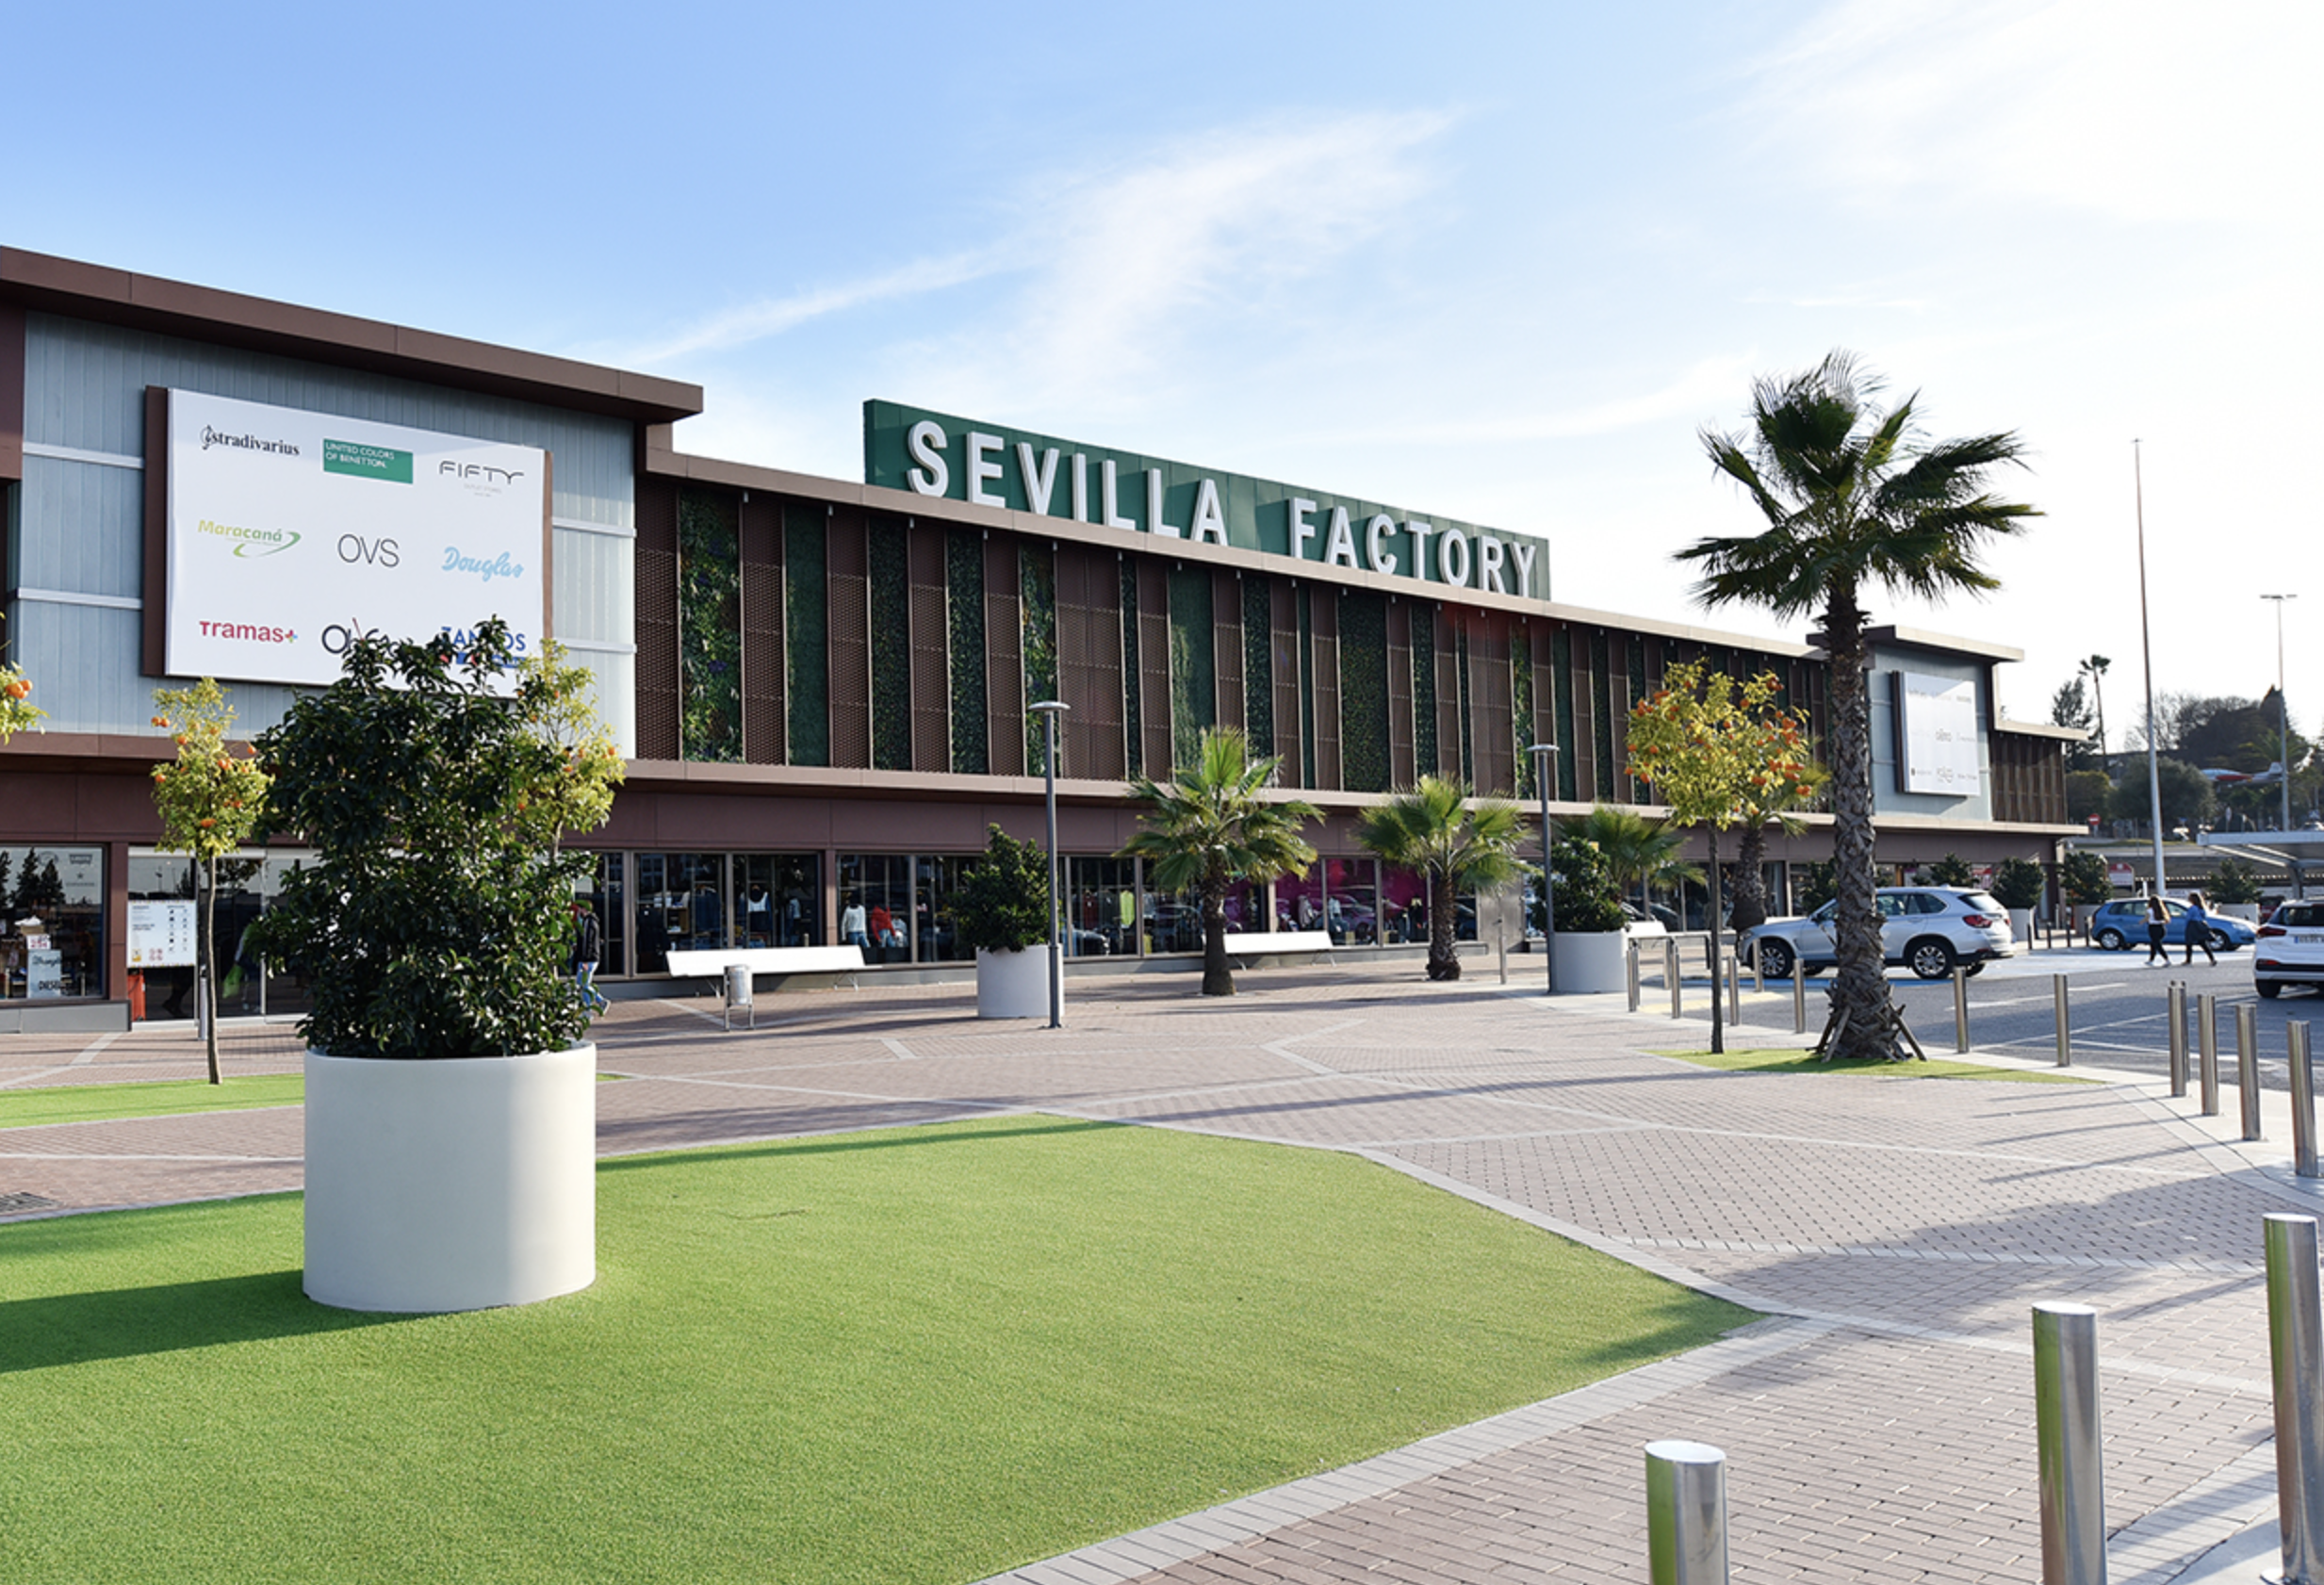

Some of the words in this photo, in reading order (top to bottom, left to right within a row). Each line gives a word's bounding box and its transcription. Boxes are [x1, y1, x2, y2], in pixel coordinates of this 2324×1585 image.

[325, 442, 358, 454] UNITED
[360, 447, 395, 460] COLORS
[325, 451, 338, 461] OF
[439, 460, 524, 484] FIFTY
[907, 420, 1228, 547] SEVILLA
[1289, 497, 1536, 597] FACTORY
[197, 519, 282, 542] Maracaná
[337, 533, 400, 567] OVS
[441, 547, 524, 581] Douglas
